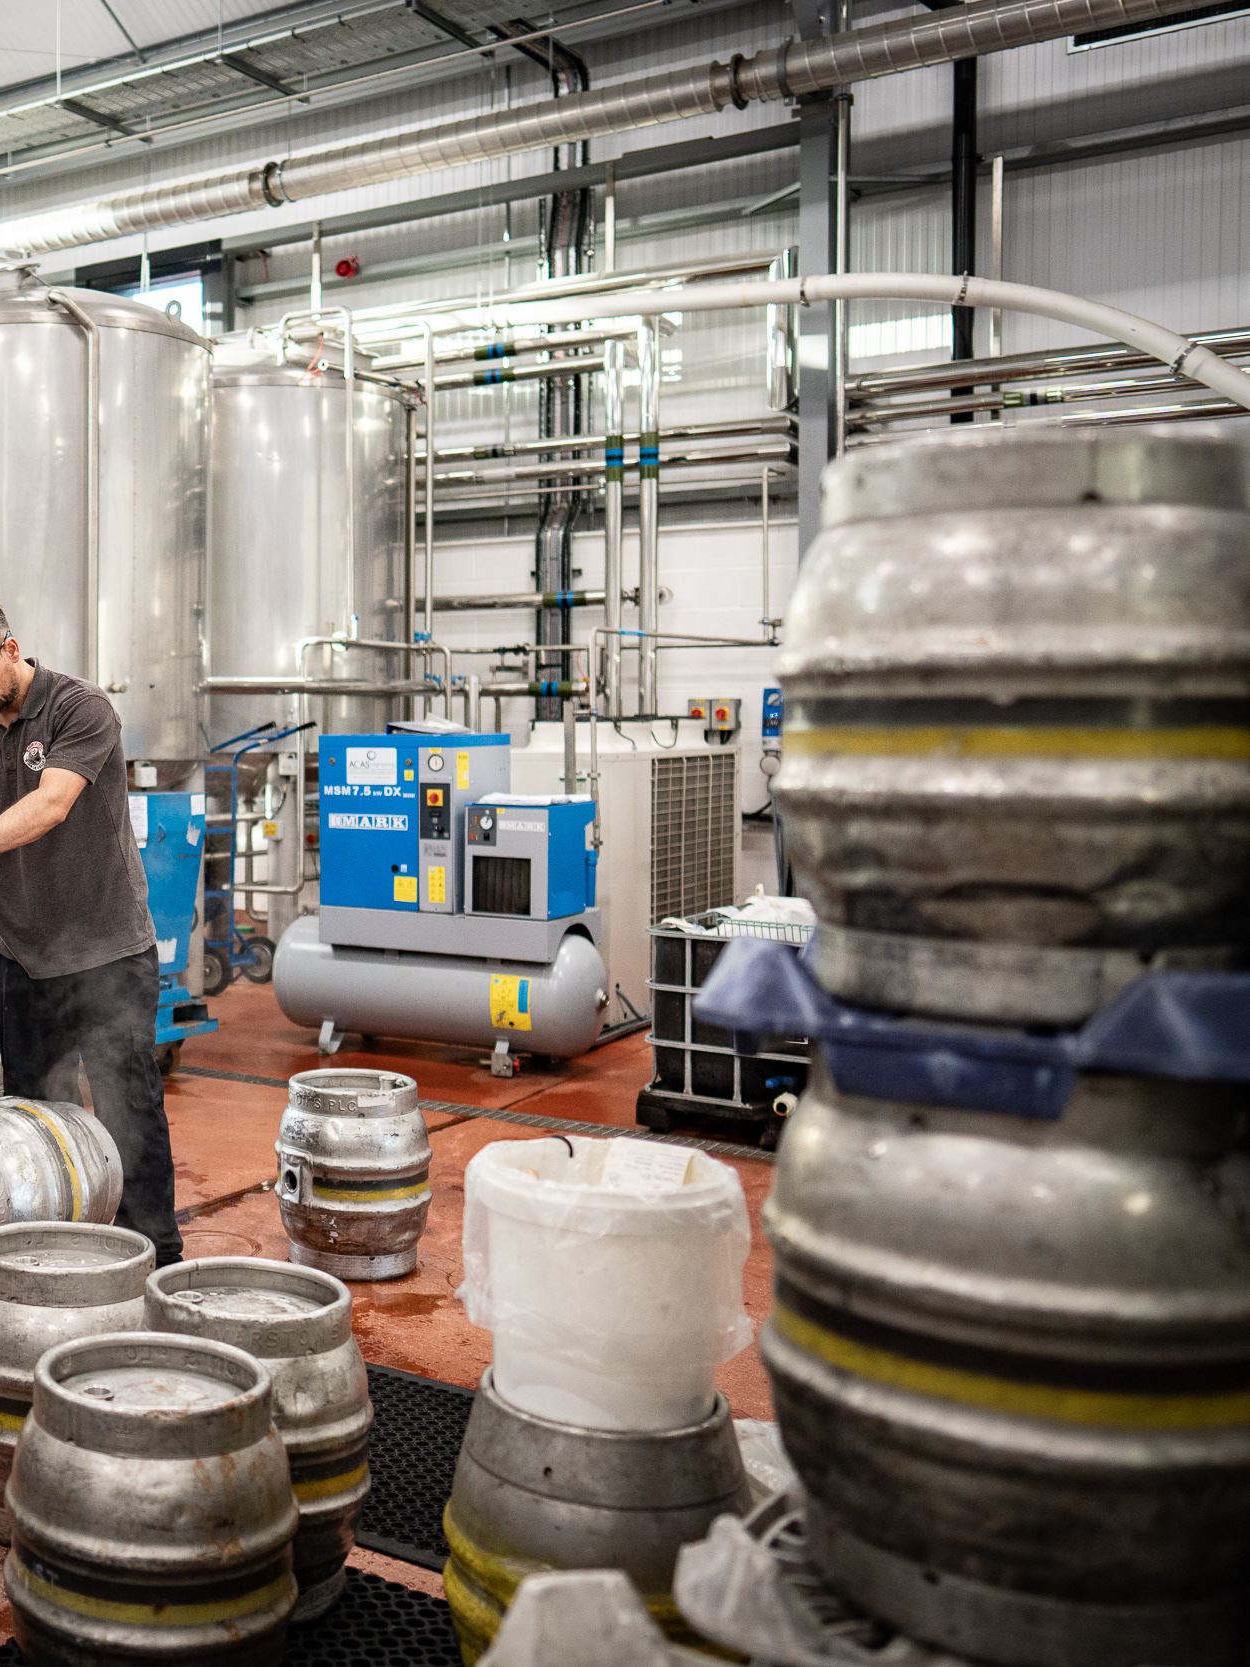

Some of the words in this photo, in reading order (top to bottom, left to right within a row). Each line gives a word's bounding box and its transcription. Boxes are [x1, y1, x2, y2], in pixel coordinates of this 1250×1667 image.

[324, 785, 351, 796] MSM
[352, 786, 371, 796] 7.5
[384, 786, 401, 797] DX
[341, 814, 407, 830] MARK
[328, 1099, 358, 1112] PLC
